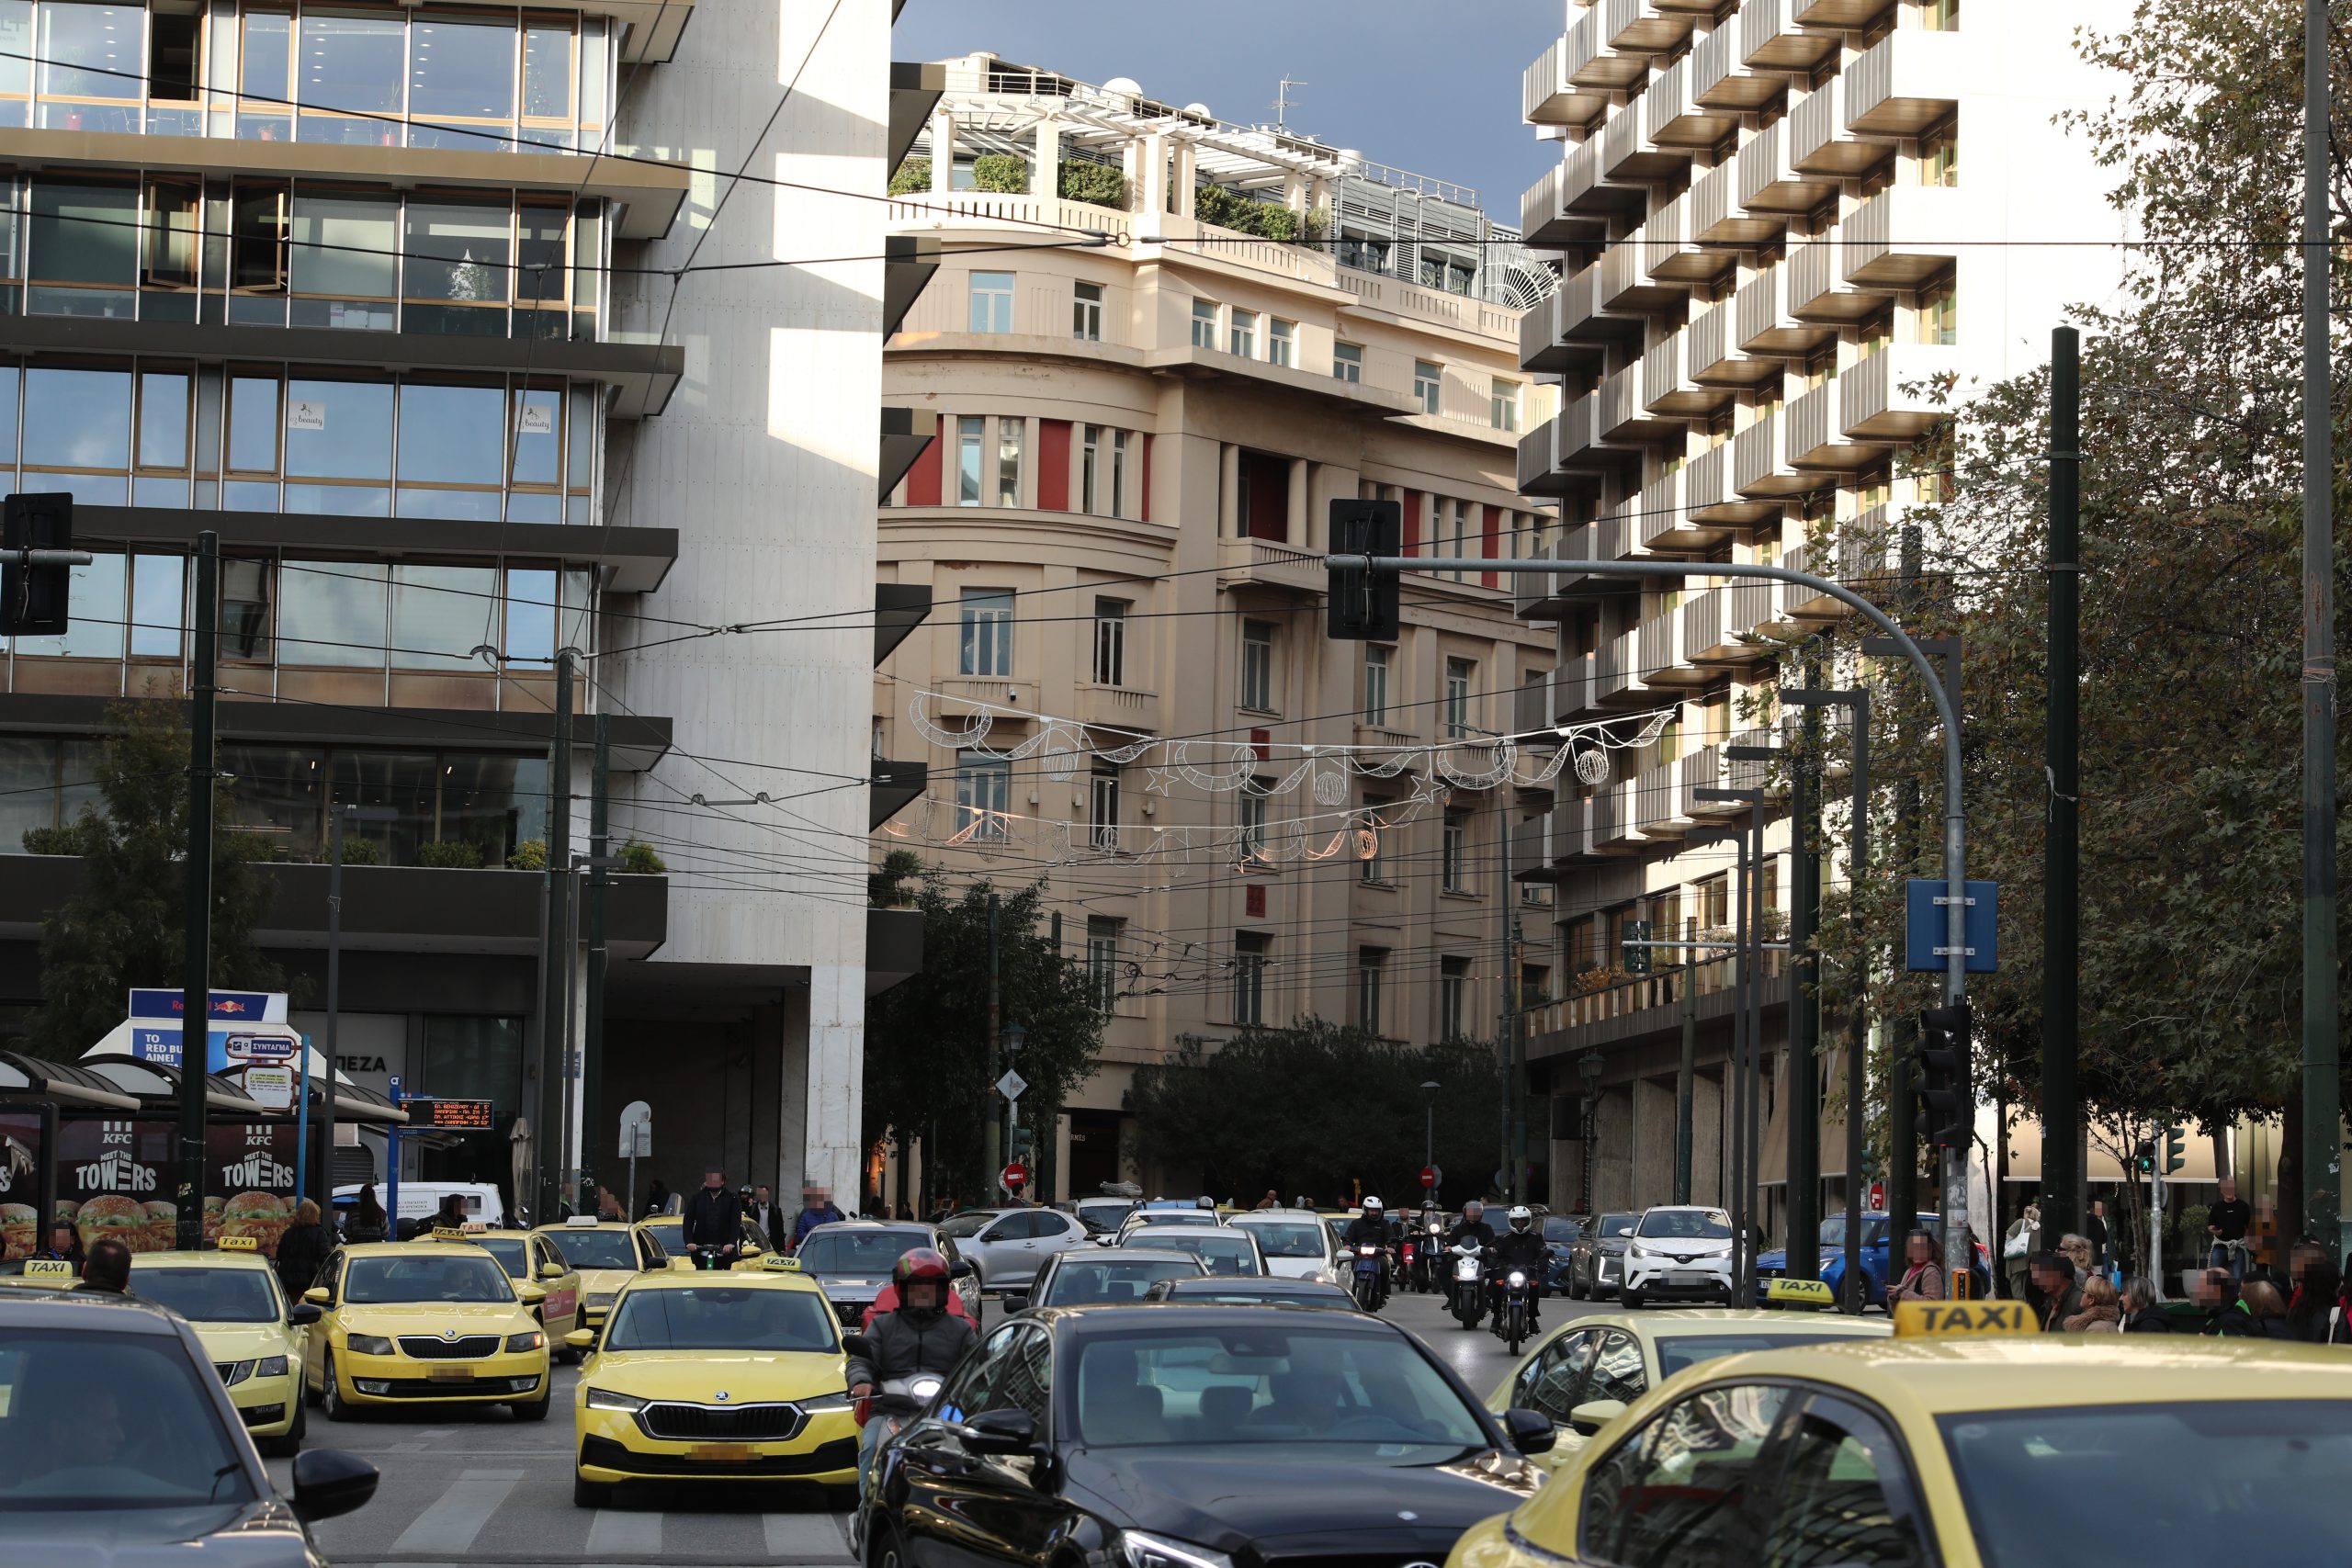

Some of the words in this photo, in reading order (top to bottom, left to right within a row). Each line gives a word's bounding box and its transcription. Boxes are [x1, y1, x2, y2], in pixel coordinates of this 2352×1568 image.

[298, 414, 322, 426] beauty
[525, 419, 549, 430] beauty
[172, 1000, 184, 1010] Re
[146, 1043, 166, 1053] RED
[169, 1044, 184, 1054] BU
[253, 1043, 290, 1052] ΣΥΝΤΑΓΜΑ
[145, 1053, 175, 1063] ΔΙΝΕΙ
[335, 1055, 387, 1072] ΠΕΖΑ
[102, 1133, 133, 1145] KFC
[245, 1135, 272, 1145] KFC
[1070, 1134, 1086, 1142] RMÈS
[100, 1150, 119, 1161] MEET
[119, 1149, 132, 1160] THE
[243, 1151, 260, 1162] MEET
[260, 1150, 273, 1161] THE
[75, 1158, 157, 1191] TOWERS
[222, 1157, 294, 1188] TOWERS
[435, 1229, 463, 1237] TAXI
[30, 1262, 66, 1272] TAXI
[768, 1258, 796, 1267] TAXI
[1779, 1280, 1824, 1293] TAXI
[1919, 1305, 2024, 1330] TAXI
